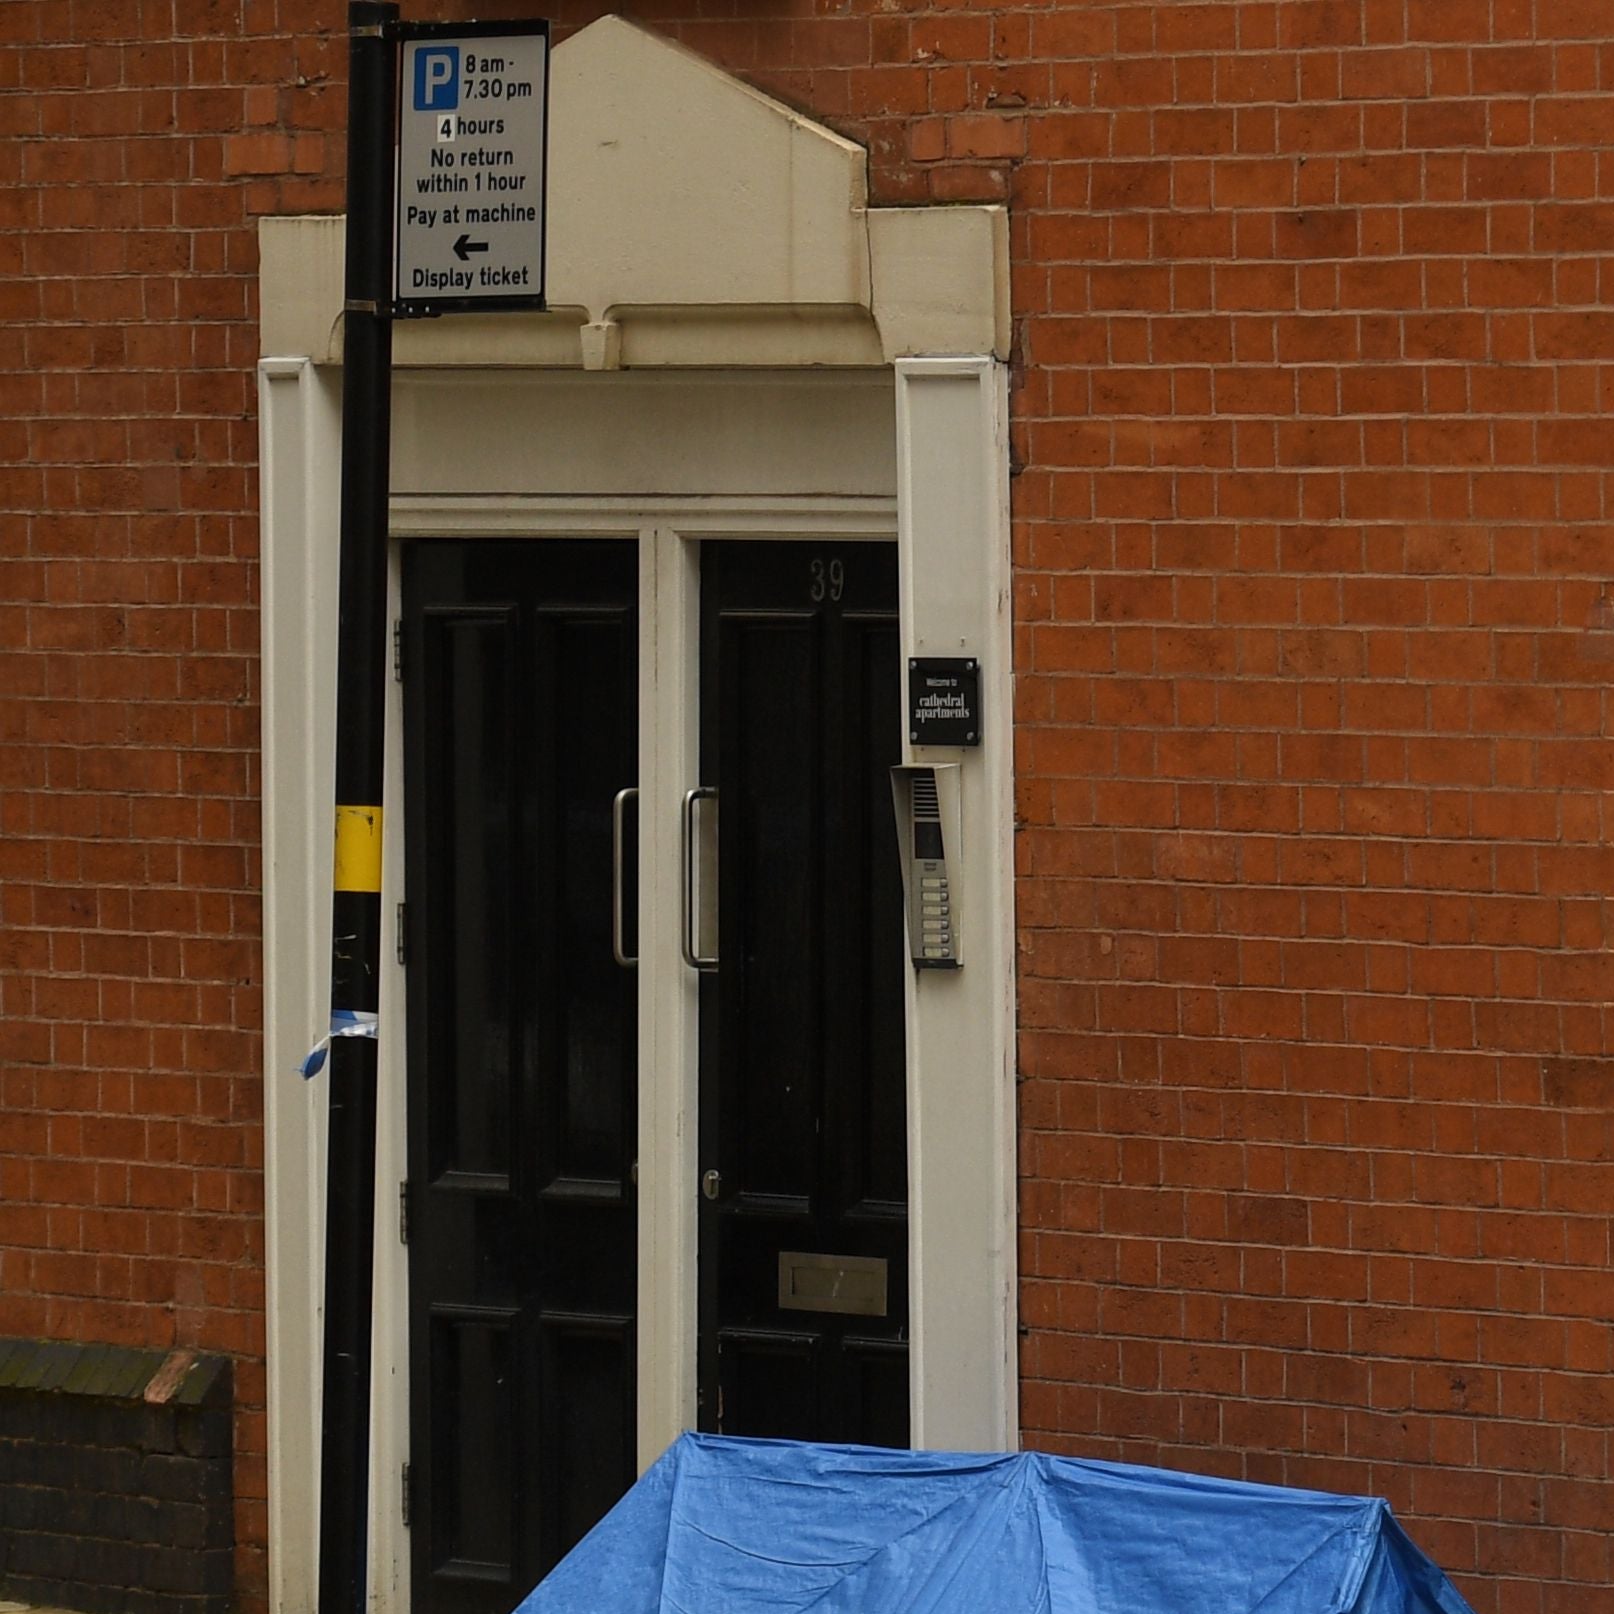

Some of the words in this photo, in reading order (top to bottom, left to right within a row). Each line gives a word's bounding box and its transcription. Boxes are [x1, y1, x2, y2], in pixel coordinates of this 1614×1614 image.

[465, 54, 477, 74] 8
[480, 57, 505, 73] am
[424, 54, 452, 105] P
[463, 78, 503, 100] 7.30
[506, 82, 532, 101] pm
[440, 118, 452, 138] 4
[457, 116, 505, 136] hours
[430, 148, 455, 168] No
[460, 148, 514, 167] return
[416, 173, 469, 193] within
[474, 172, 481, 192] 1
[487, 172, 527, 191] hour
[407, 205, 437, 228] Pay
[442, 205, 460, 224] at
[465, 203, 536, 224] machine
[412, 268, 474, 290] Display
[479, 266, 529, 286] ticket
[811, 559, 844, 601] 39
[919, 692, 965, 707] cathedral
[915, 707, 970, 724] apartments
